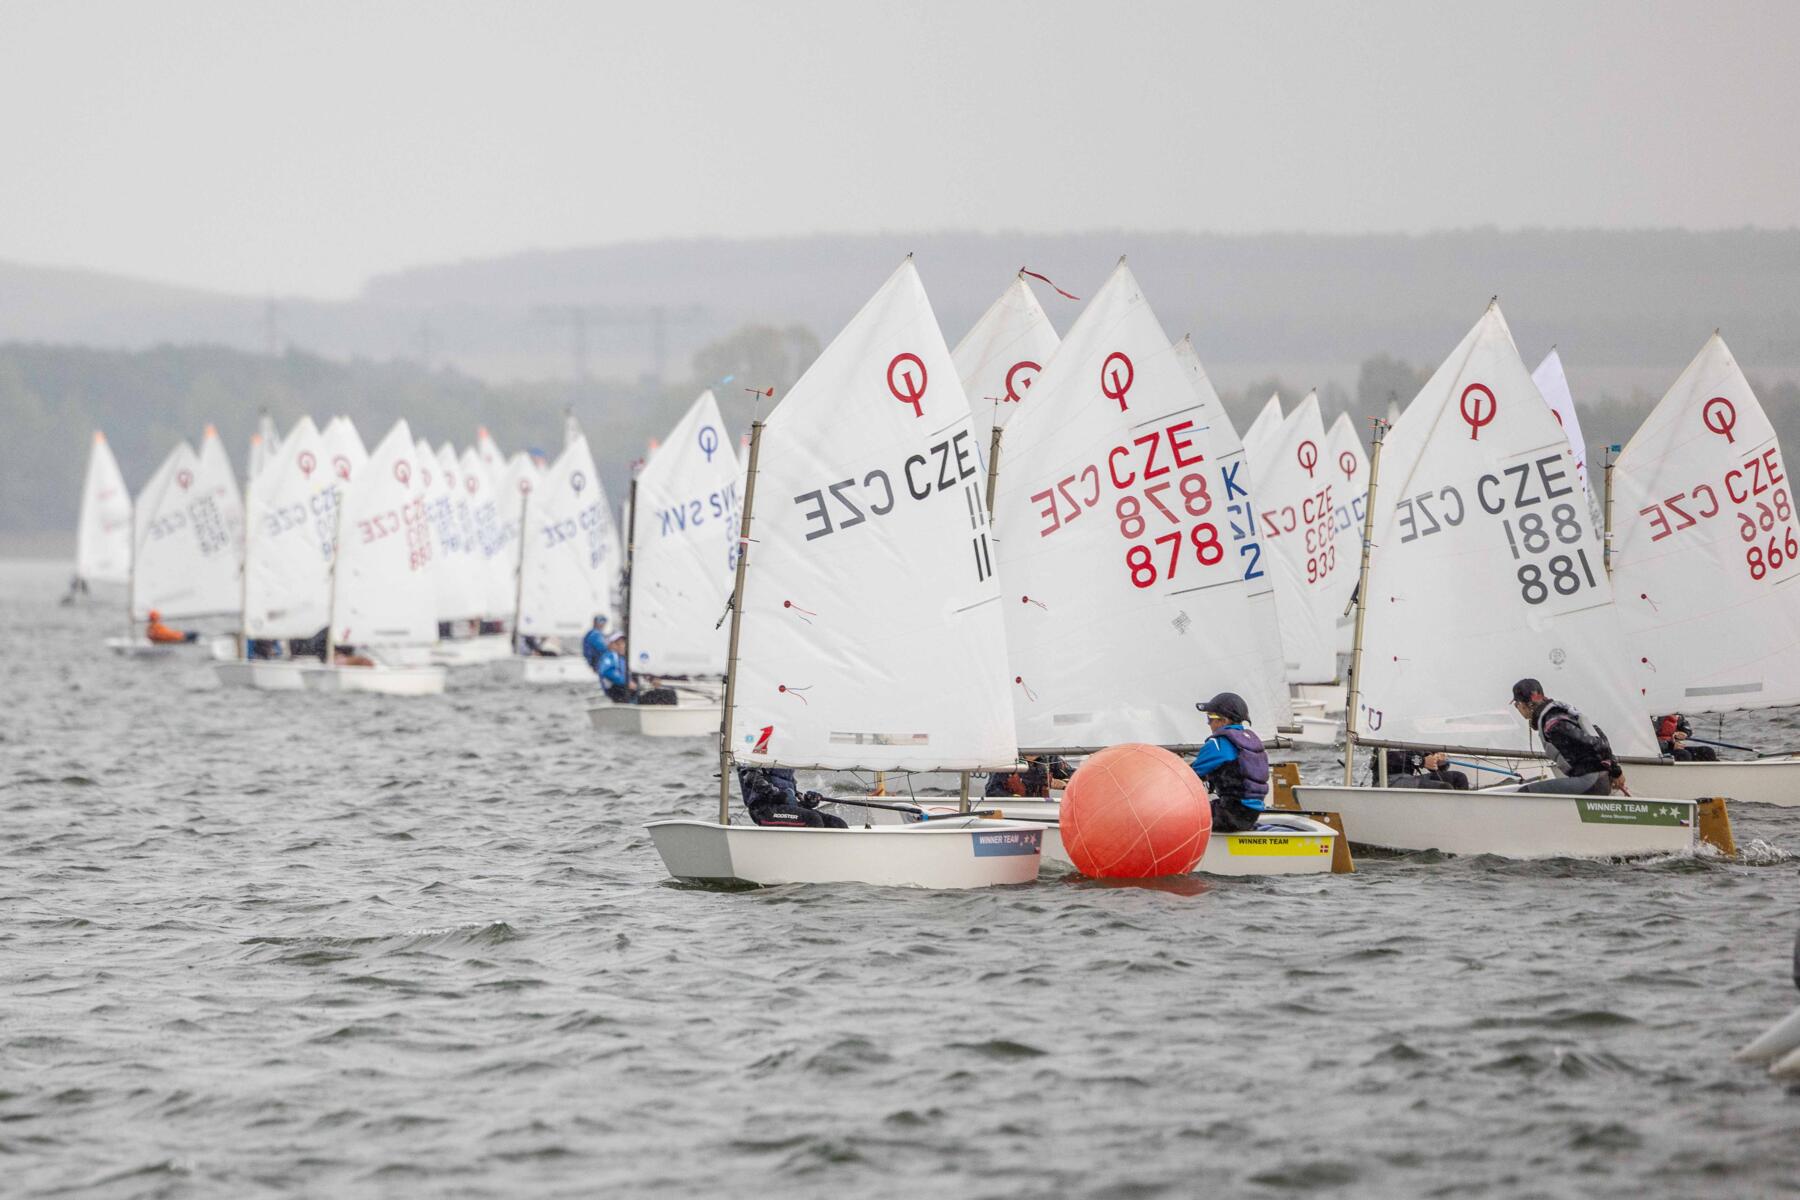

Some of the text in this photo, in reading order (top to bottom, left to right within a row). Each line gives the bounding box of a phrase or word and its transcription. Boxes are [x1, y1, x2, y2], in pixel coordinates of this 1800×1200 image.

[904, 430, 976, 500] CZE
[1108, 420, 1204, 489] CZE
[1724, 448, 1784, 504] CZE
[1302, 485, 1334, 525] CZE
[1477, 454, 1573, 515] CZE
[973, 534, 992, 581] 11
[1126, 522, 1224, 588] 878
[1307, 545, 1335, 584] 933
[1517, 548, 1597, 605] 881
[1746, 526, 1799, 580] 866
[1586, 802, 1648, 812] WINNER TEAM
[980, 834, 1019, 844] WINNER TEAM
